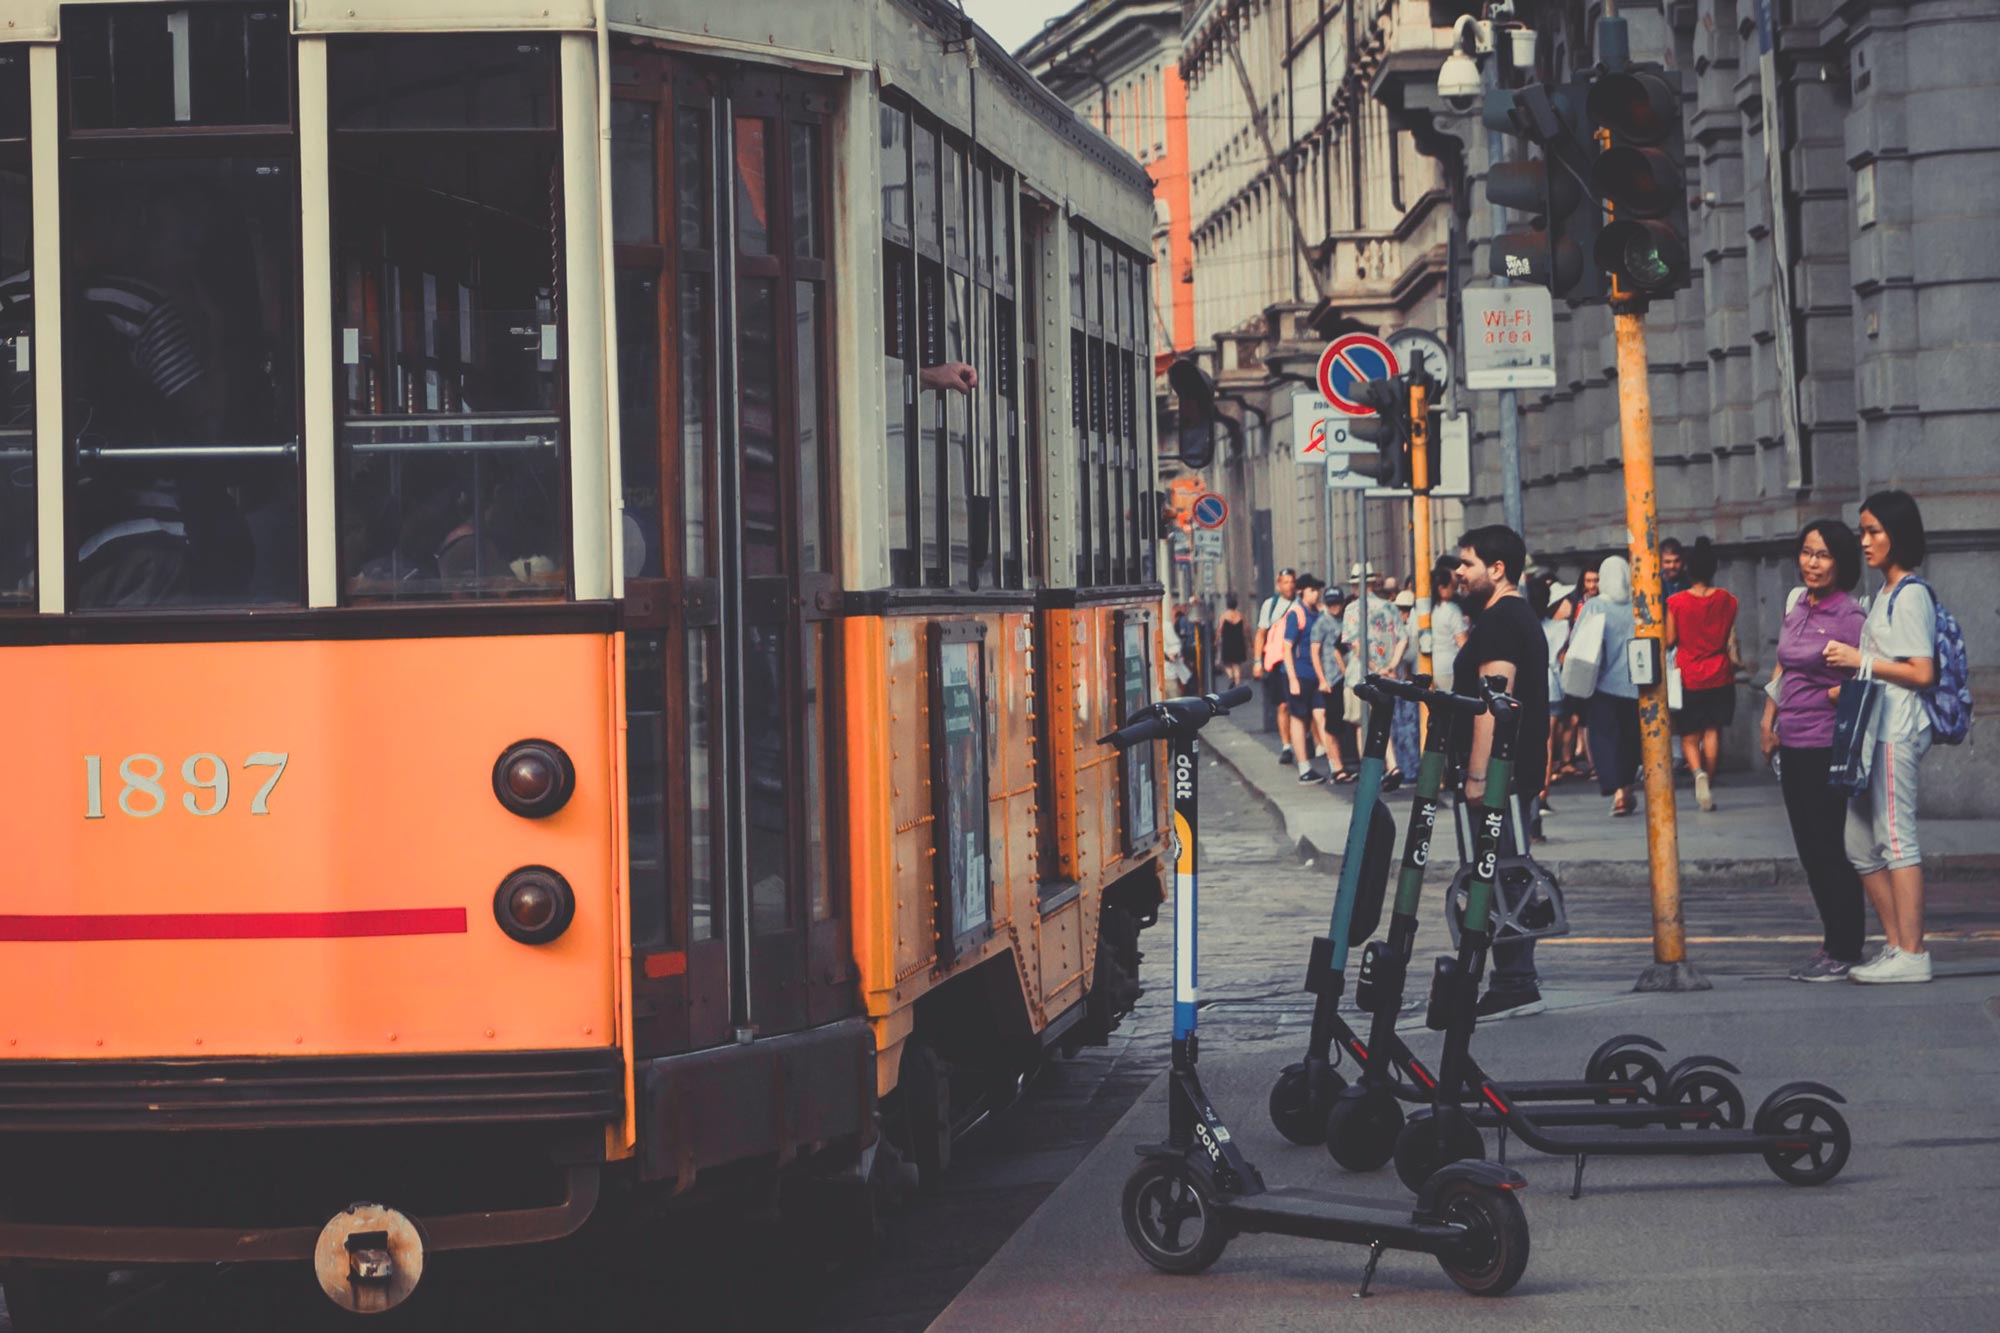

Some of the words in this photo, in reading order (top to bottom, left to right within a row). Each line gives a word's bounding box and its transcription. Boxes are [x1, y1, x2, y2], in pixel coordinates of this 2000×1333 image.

[167, 9, 191, 121] 1
[1482, 309, 1531, 327] Wi-Fi
[1485, 330, 1532, 344] area
[84, 751, 289, 819] 1897
[1176, 754, 1192, 799] dott
[1196, 1123, 1220, 1162] dott
